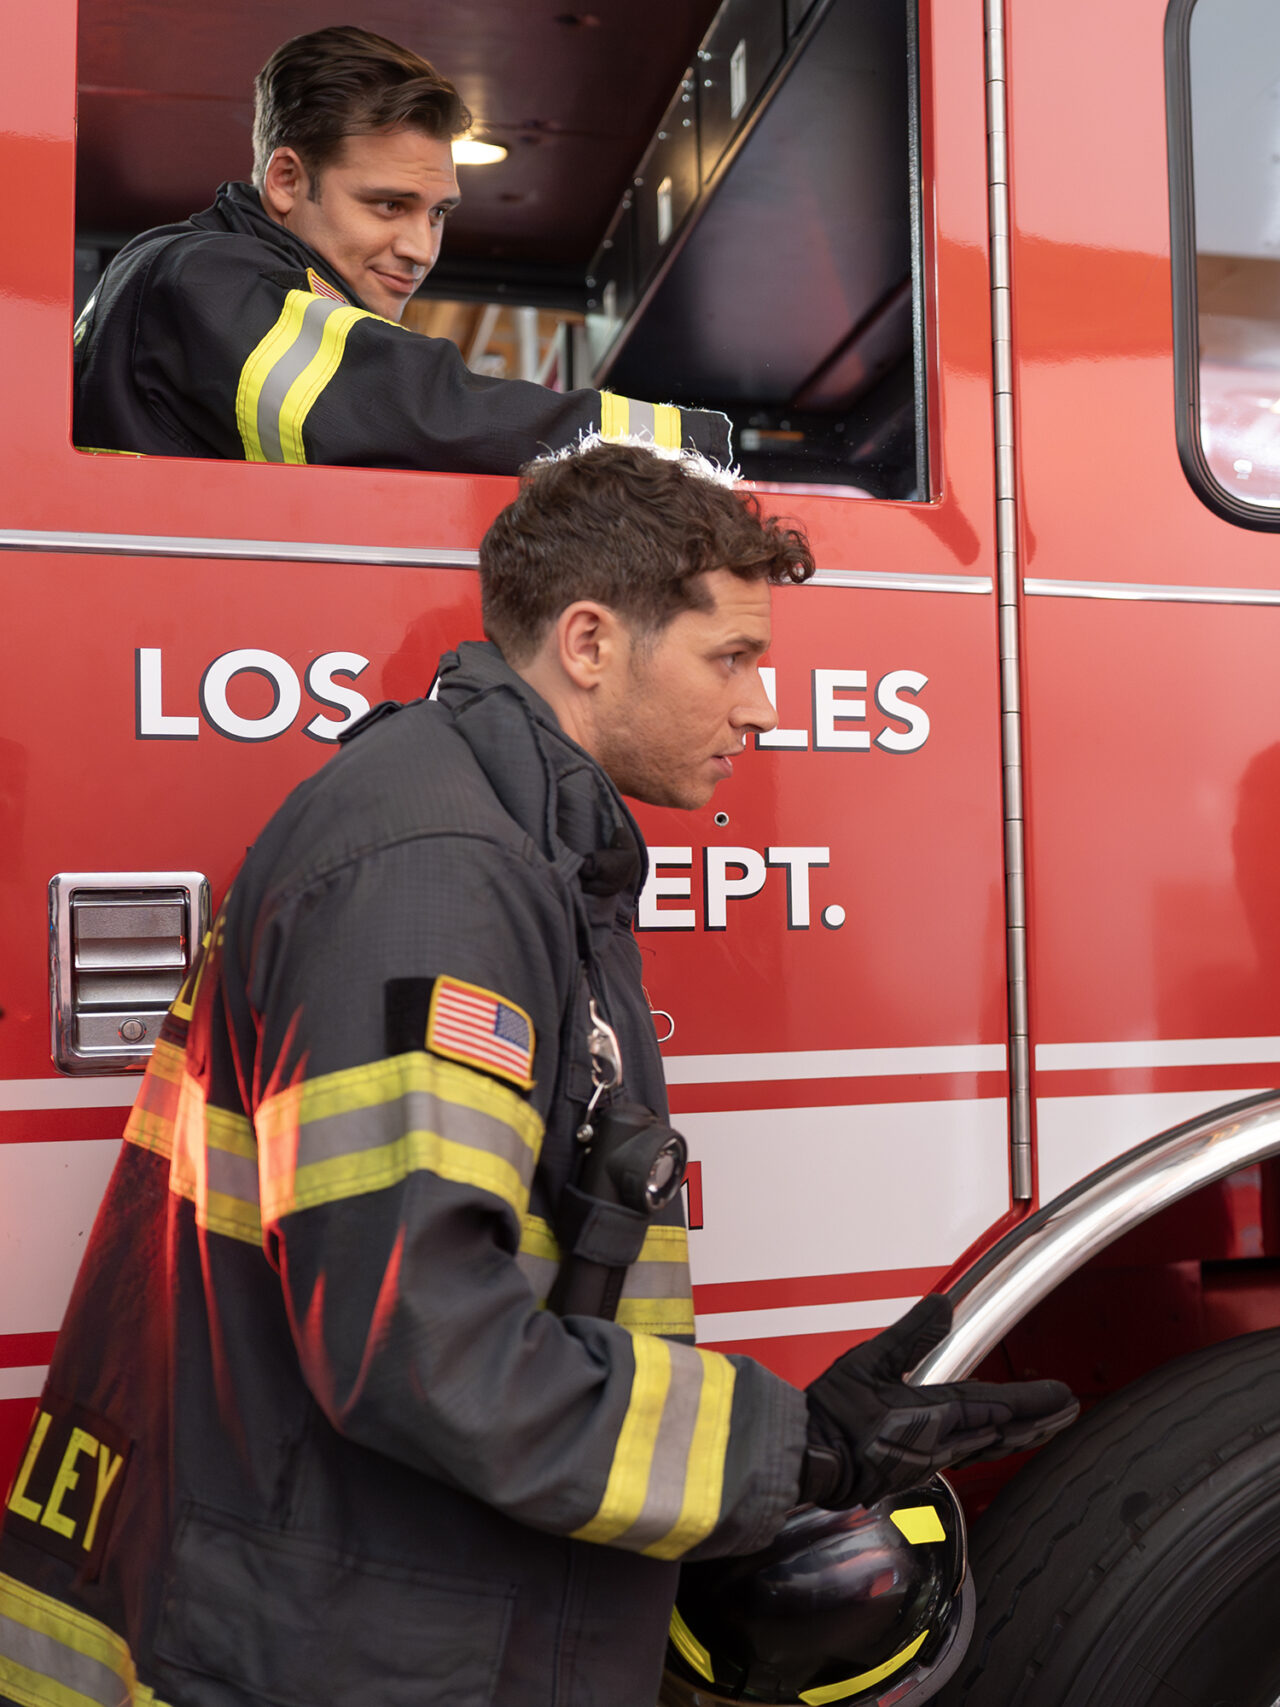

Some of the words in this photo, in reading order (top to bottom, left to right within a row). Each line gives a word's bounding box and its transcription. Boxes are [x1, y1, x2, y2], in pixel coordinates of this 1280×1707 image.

[135, 648, 370, 744] LOS
[743, 667, 930, 754] LES
[633, 846, 846, 932] EPT.
[5, 1407, 124, 1552] LEY
